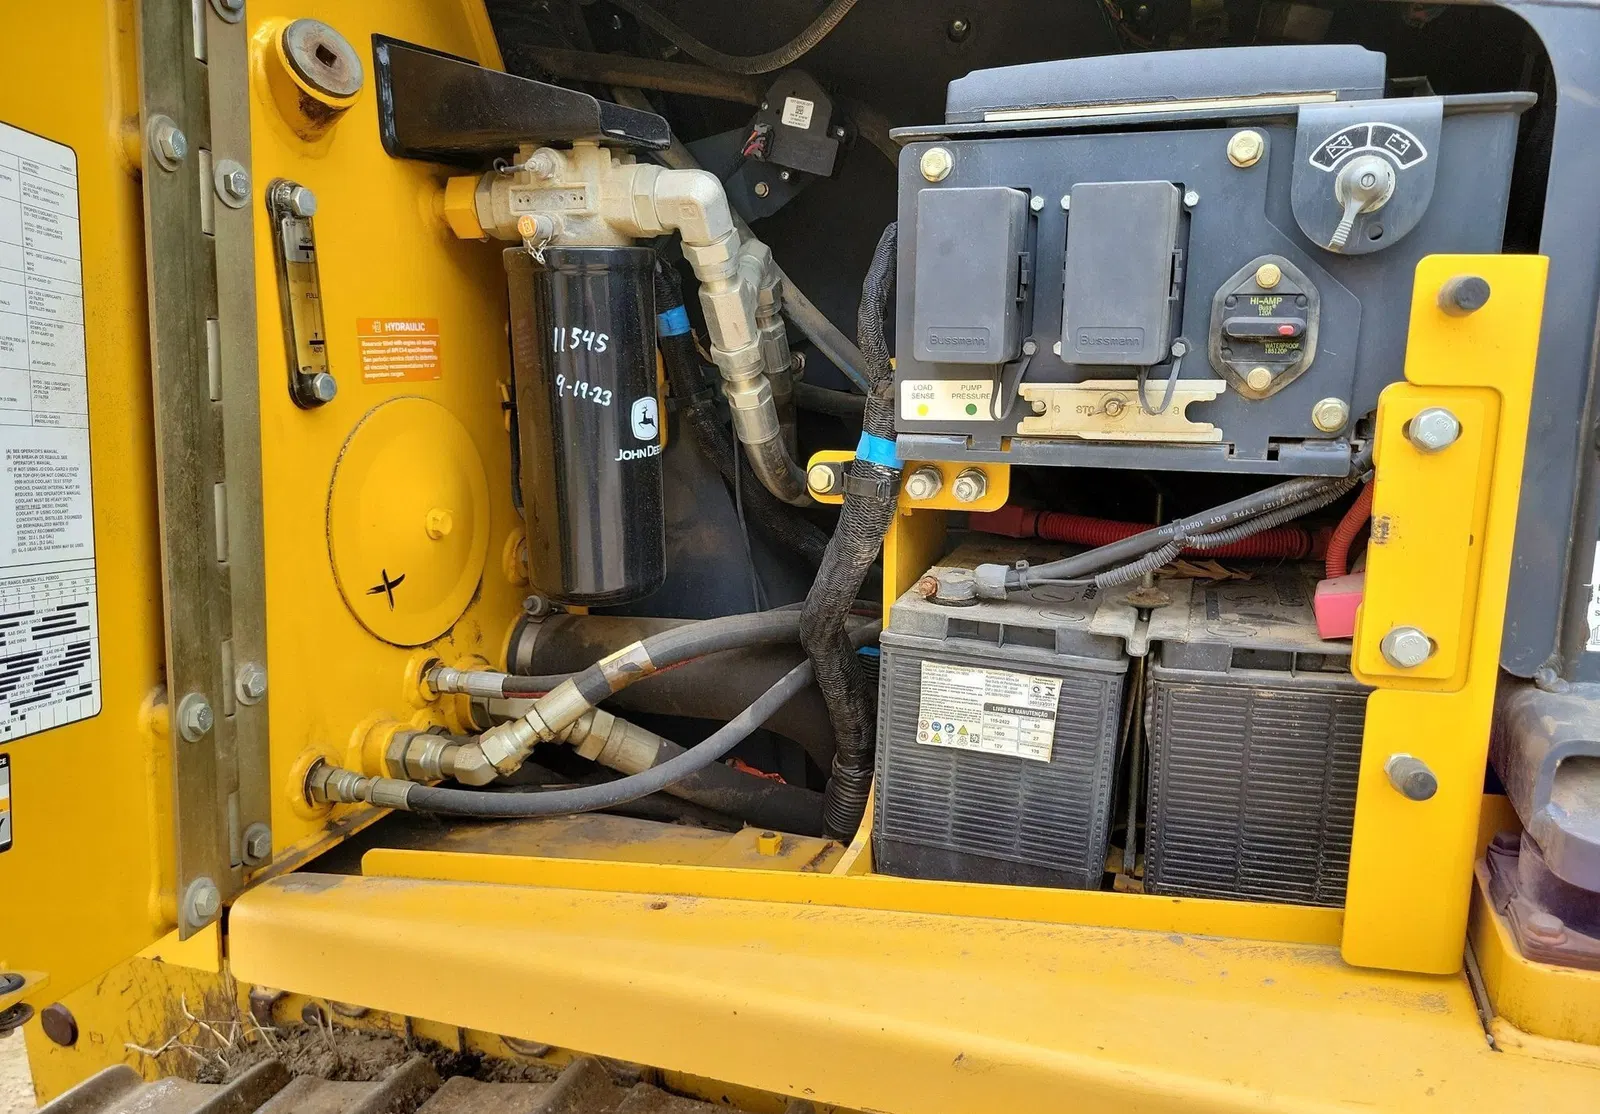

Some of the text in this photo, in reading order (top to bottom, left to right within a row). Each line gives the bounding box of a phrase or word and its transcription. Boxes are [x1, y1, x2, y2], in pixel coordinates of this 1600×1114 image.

[1250, 297, 1282, 305] HI-AMP
[385, 322, 425, 331] HYDRAULIC
[554, 327, 609, 353] 11545
[930, 335, 985, 347] Bussmann
[1080, 334, 1140, 346] Bussmann
[556, 373, 613, 406] 9-19-23
[614, 444, 662, 462] JOHN DEE
[1232, 508, 1256, 519] TYPE
[1015, 708, 1049, 718] MANUTENÇÃO
